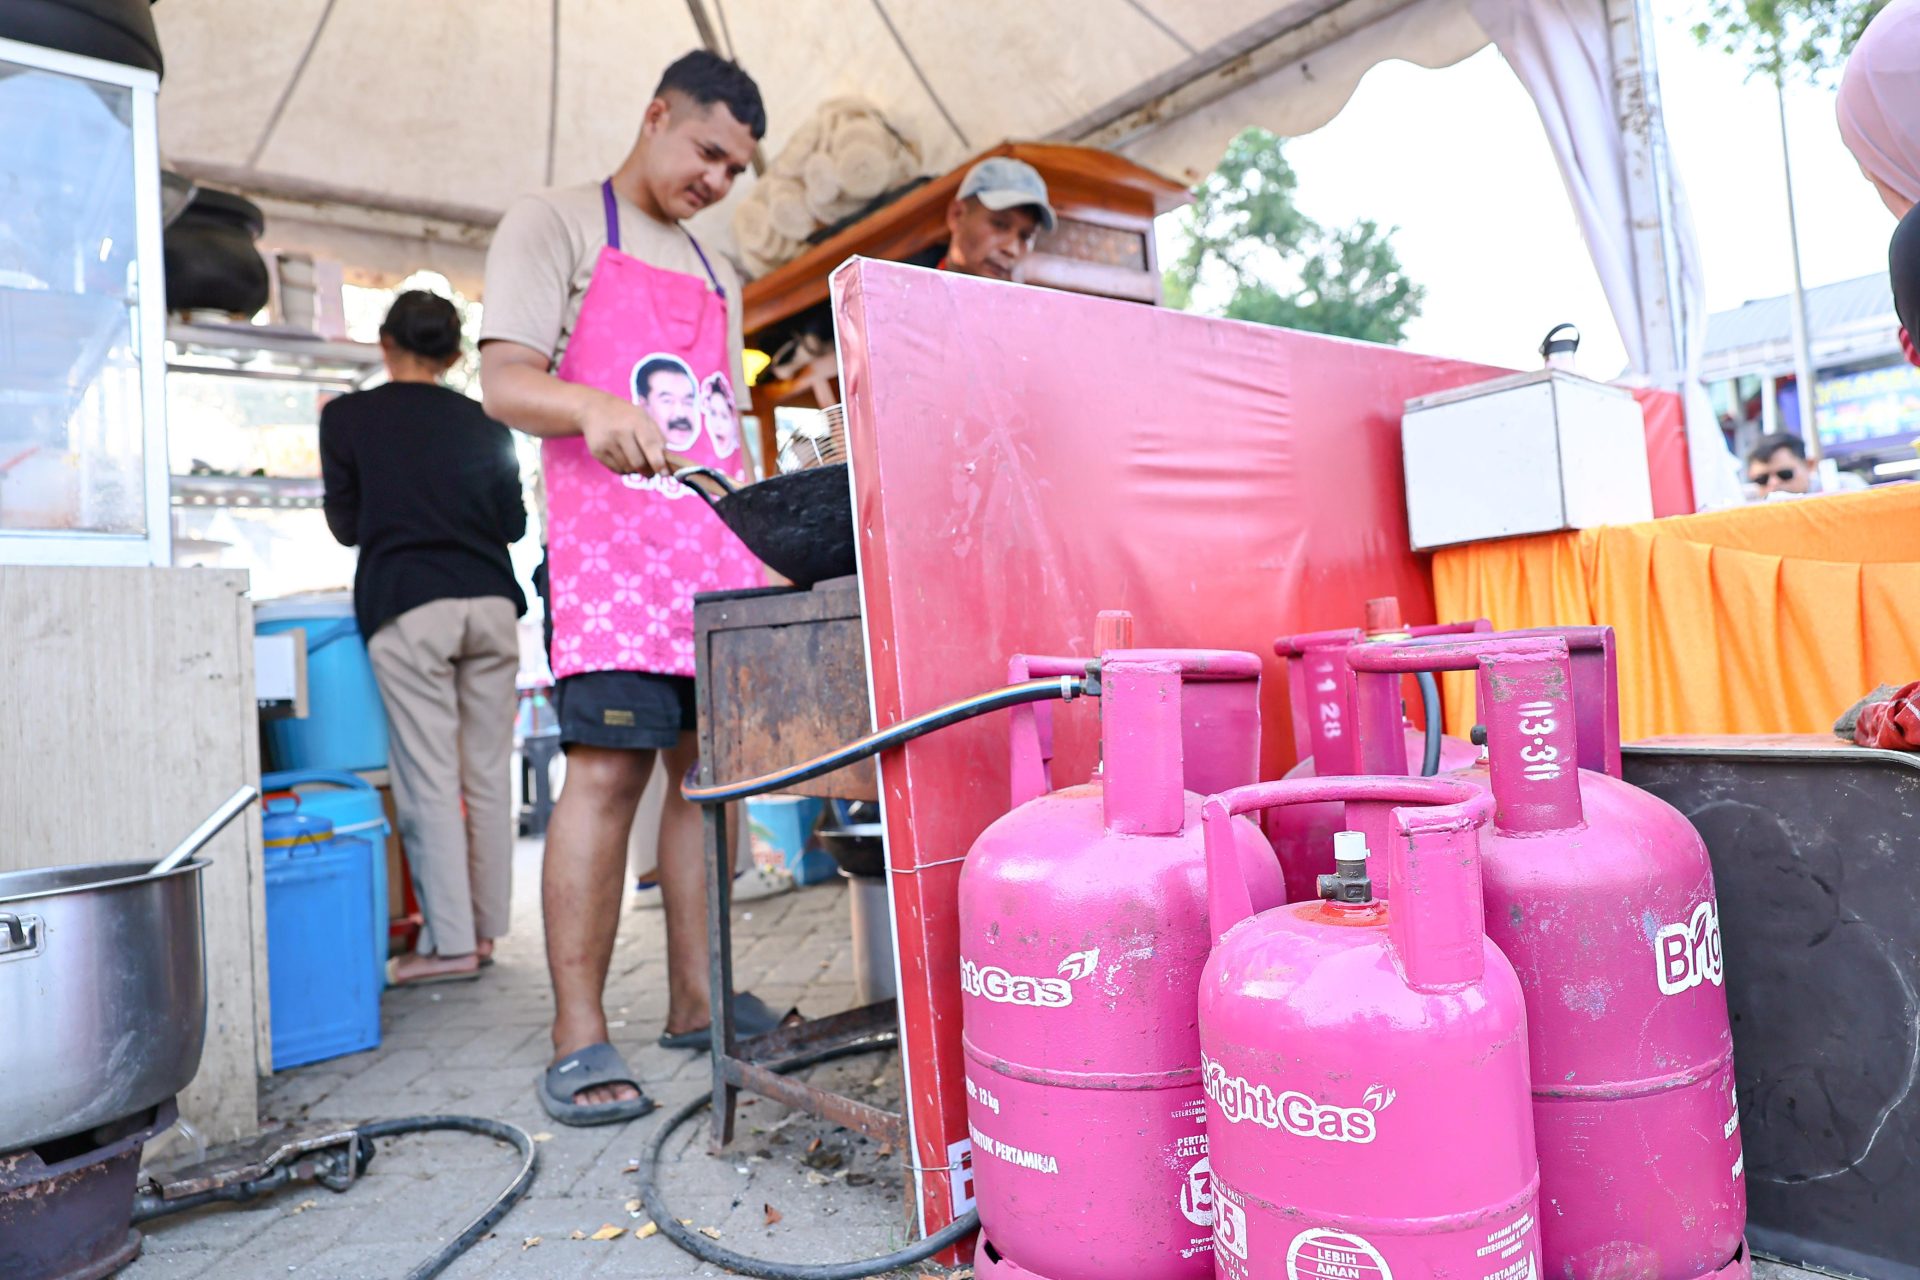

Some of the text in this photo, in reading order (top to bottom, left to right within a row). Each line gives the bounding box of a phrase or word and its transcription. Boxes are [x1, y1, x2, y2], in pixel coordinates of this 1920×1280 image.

[1655, 902, 1724, 995] Brig
[1177, 1133, 1208, 1147] PERTA
[1177, 1144, 1199, 1157] CALL
[1317, 1247, 1357, 1265] LEBIH
[1316, 1263, 1360, 1279] AMAN
